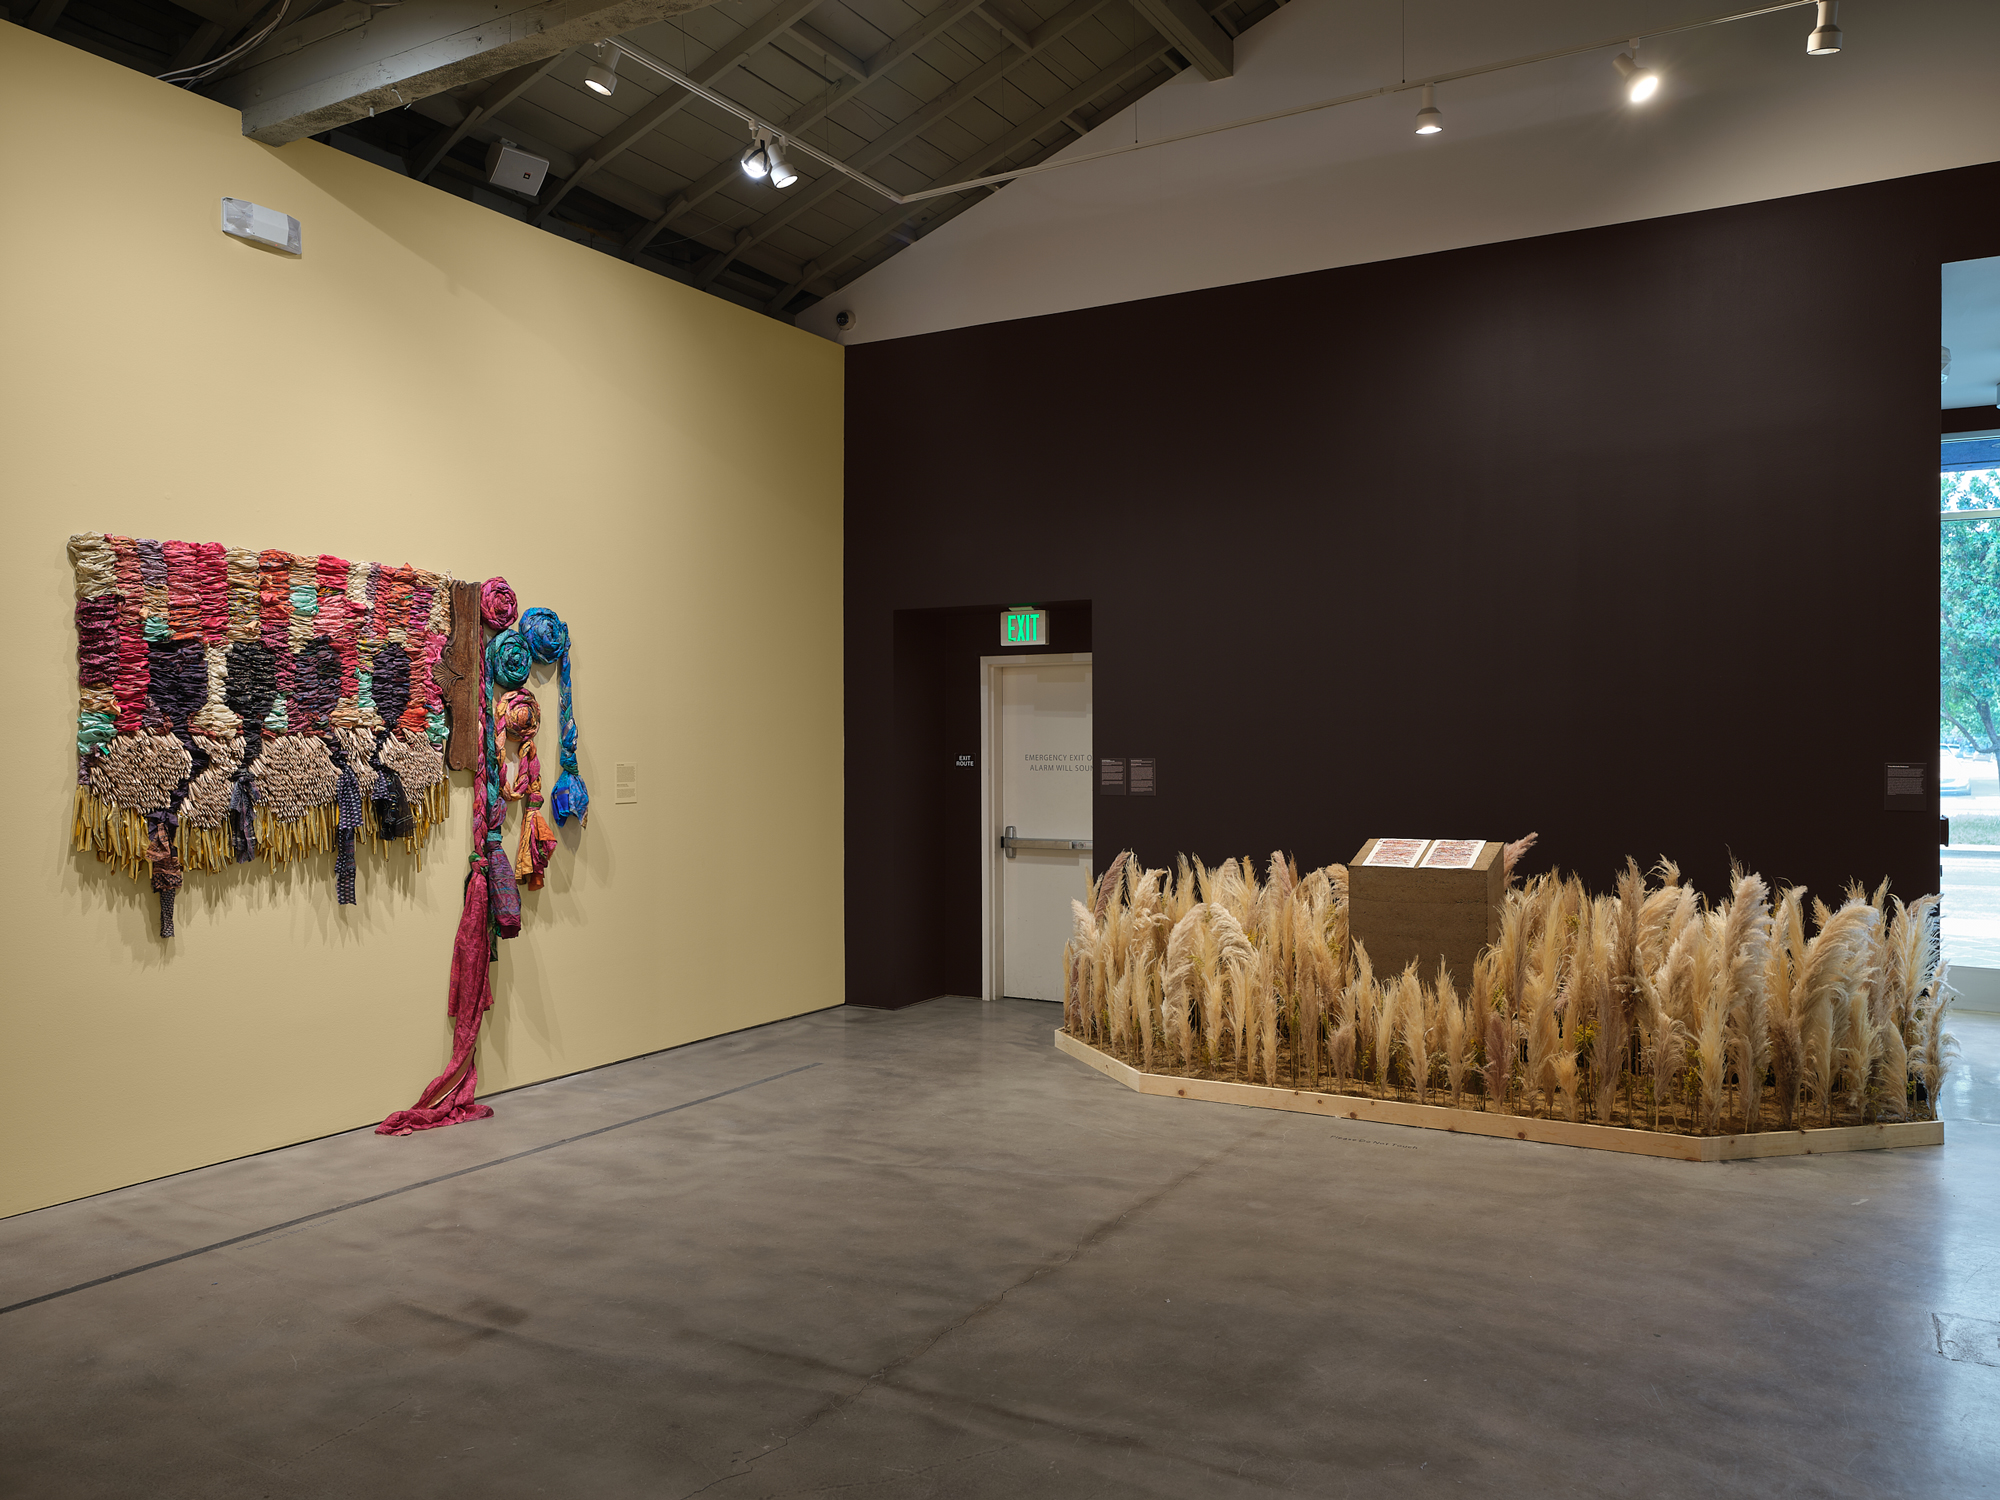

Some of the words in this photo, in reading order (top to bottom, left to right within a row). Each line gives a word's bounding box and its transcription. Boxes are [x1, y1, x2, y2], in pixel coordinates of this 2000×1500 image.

[1008, 613, 1040, 642] EXIT
[1024, 754, 1068, 762] EMERGENCY
[1069, 754, 1085, 762] EXIT
[1029, 764, 1054, 772] ALARM
[1055, 764, 1073, 772] WILL
